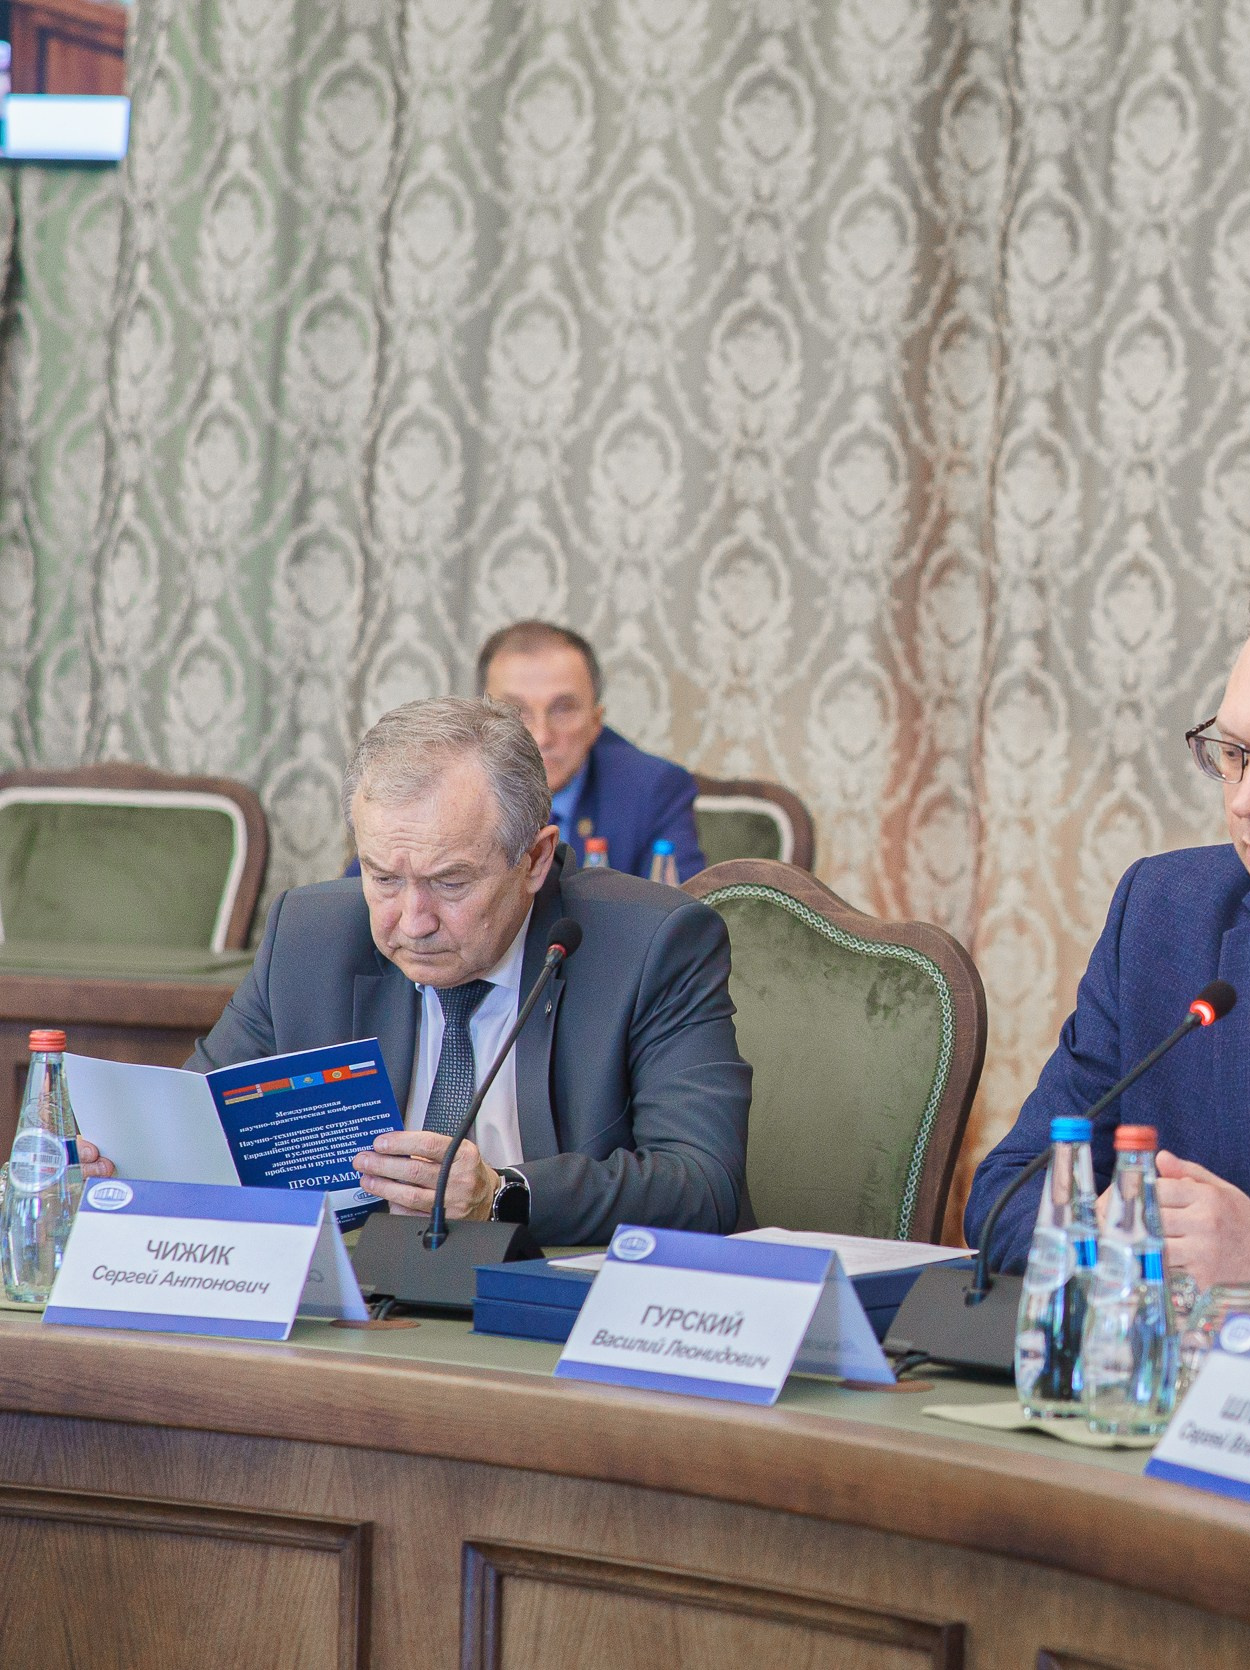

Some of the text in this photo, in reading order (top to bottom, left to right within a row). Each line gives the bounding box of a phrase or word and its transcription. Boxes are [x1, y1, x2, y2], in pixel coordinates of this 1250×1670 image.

[239, 1099, 382, 1132] научно-практическая конференция
[276, 1100, 341, 1118] Международная
[239, 1112, 390, 1148] Научно-техническое сотрудничество
[244, 1126, 394, 1161] Евразийского экономического союза
[274, 1126, 359, 1147] как основа развития
[272, 1151, 336, 1168] экономических
[292, 1144, 329, 1158] условиях
[330, 1140, 356, 1150] новых
[264, 1163, 307, 1177] проблемы
[315, 1158, 336, 1168] пути
[336, 1156, 348, 1164] их
[288, 1171, 361, 1190] ПРОГРАММ
[146, 1239, 235, 1266] ЧИЖИК
[92, 1265, 270, 1294] Сергей Антонович
[640, 1305, 745, 1337] ГУРСКИЙ
[591, 1329, 770, 1370] Василий Леонидович
